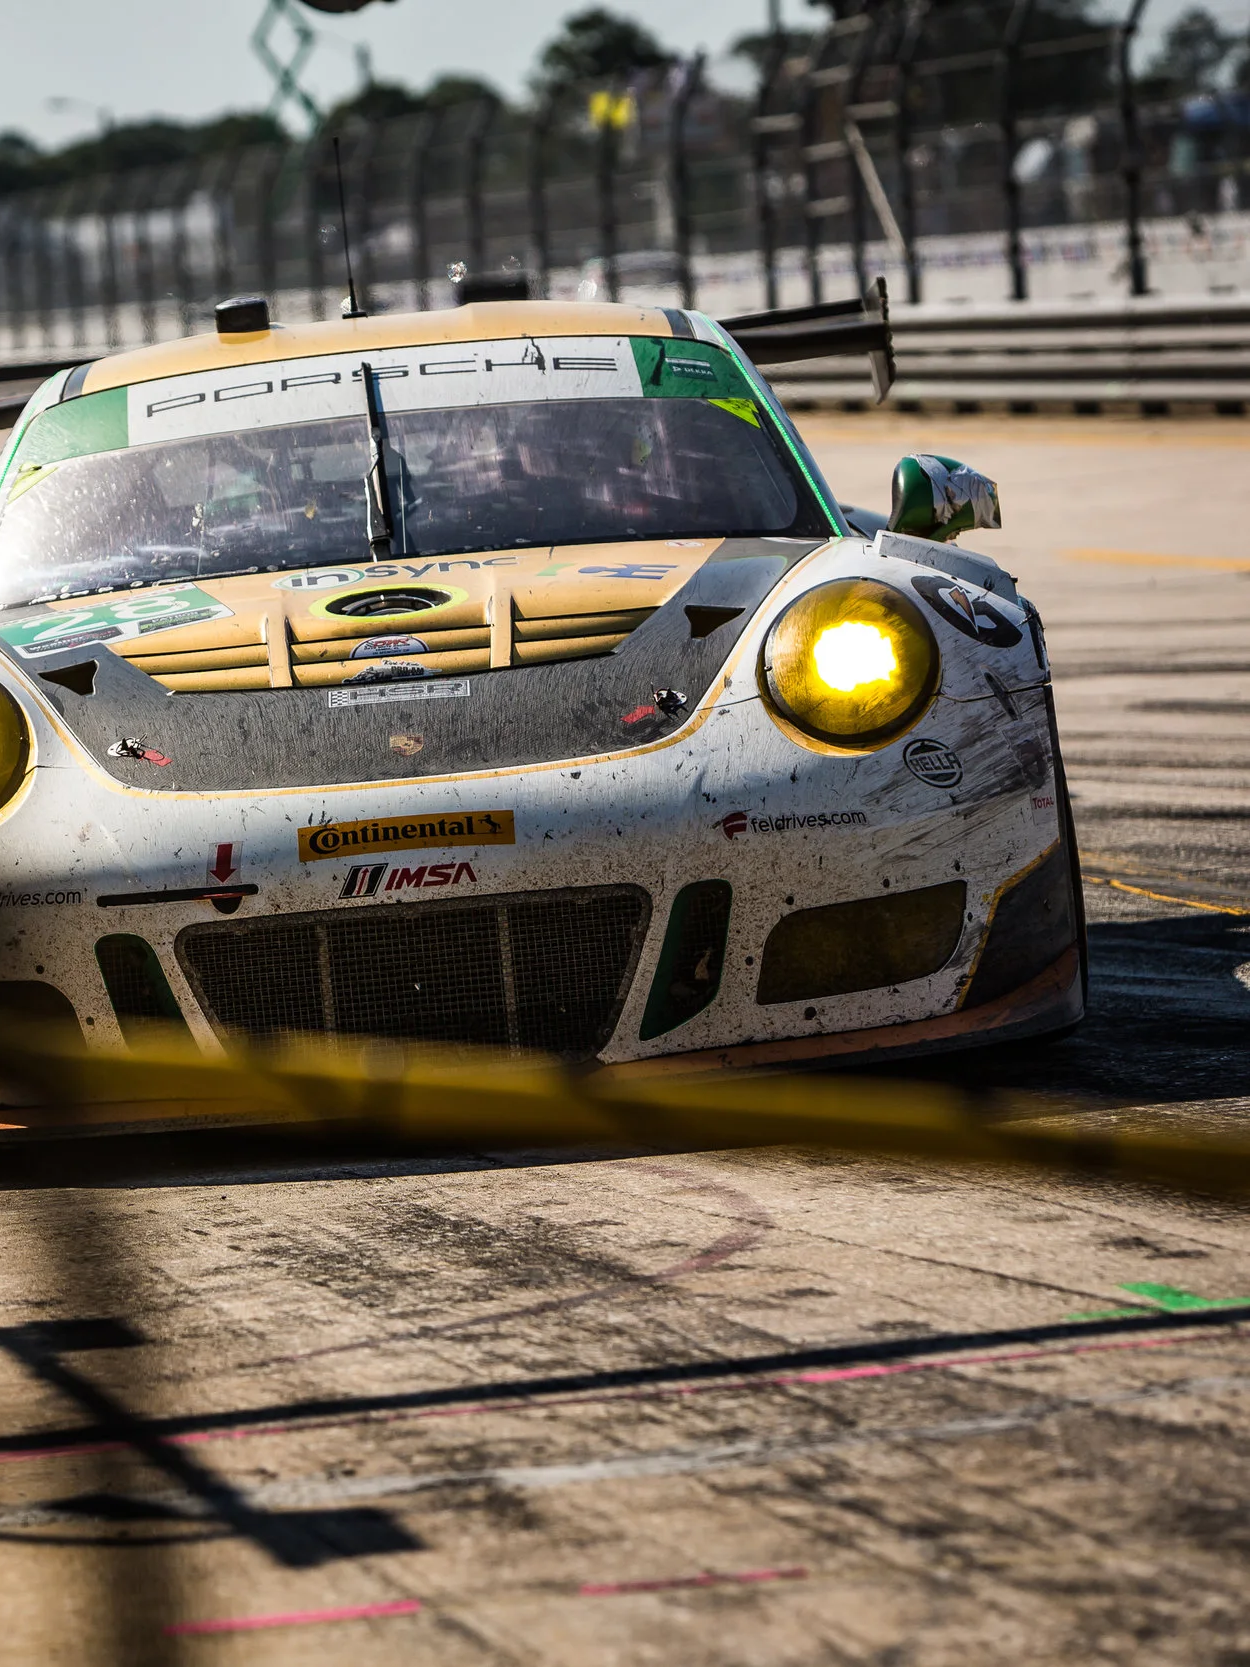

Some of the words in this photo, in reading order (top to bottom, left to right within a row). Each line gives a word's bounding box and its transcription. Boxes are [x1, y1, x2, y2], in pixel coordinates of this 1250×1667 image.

[146, 356, 618, 418] PORSCHE
[21, 596, 190, 642] 28
[909, 748, 962, 771] HELLA
[1033, 796, 1054, 810] TOTAL
[309, 816, 476, 855] Continental
[750, 810, 867, 835] feldrives.com
[384, 862, 478, 891] IMSA
